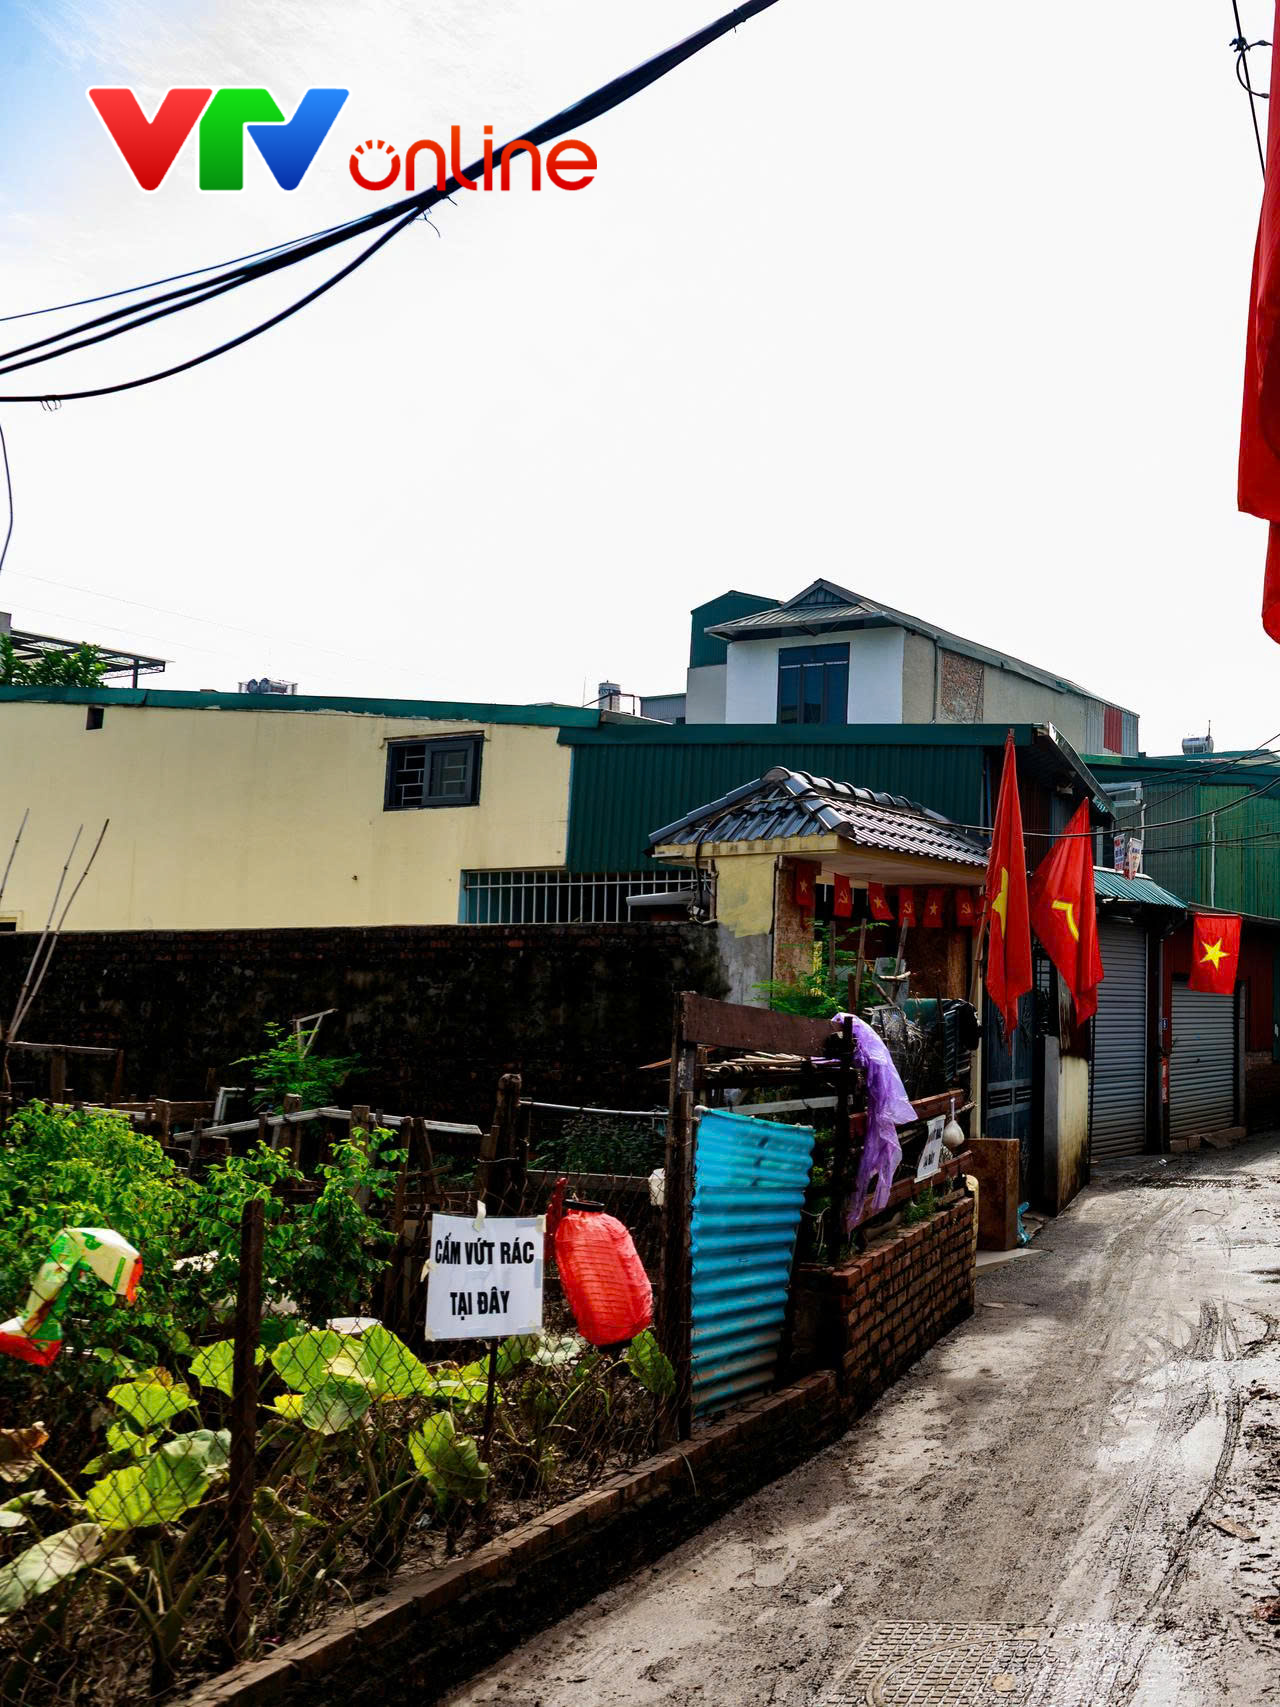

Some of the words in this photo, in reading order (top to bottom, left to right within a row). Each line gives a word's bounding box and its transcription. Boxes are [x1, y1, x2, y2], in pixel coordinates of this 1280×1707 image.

[435, 1232, 461, 1265] CẤM
[465, 1237, 495, 1265] VỨT
[500, 1237, 535, 1265] RÁC
[450, 1292, 472, 1320] TẠI
[477, 1286, 510, 1315] ĐÂY
